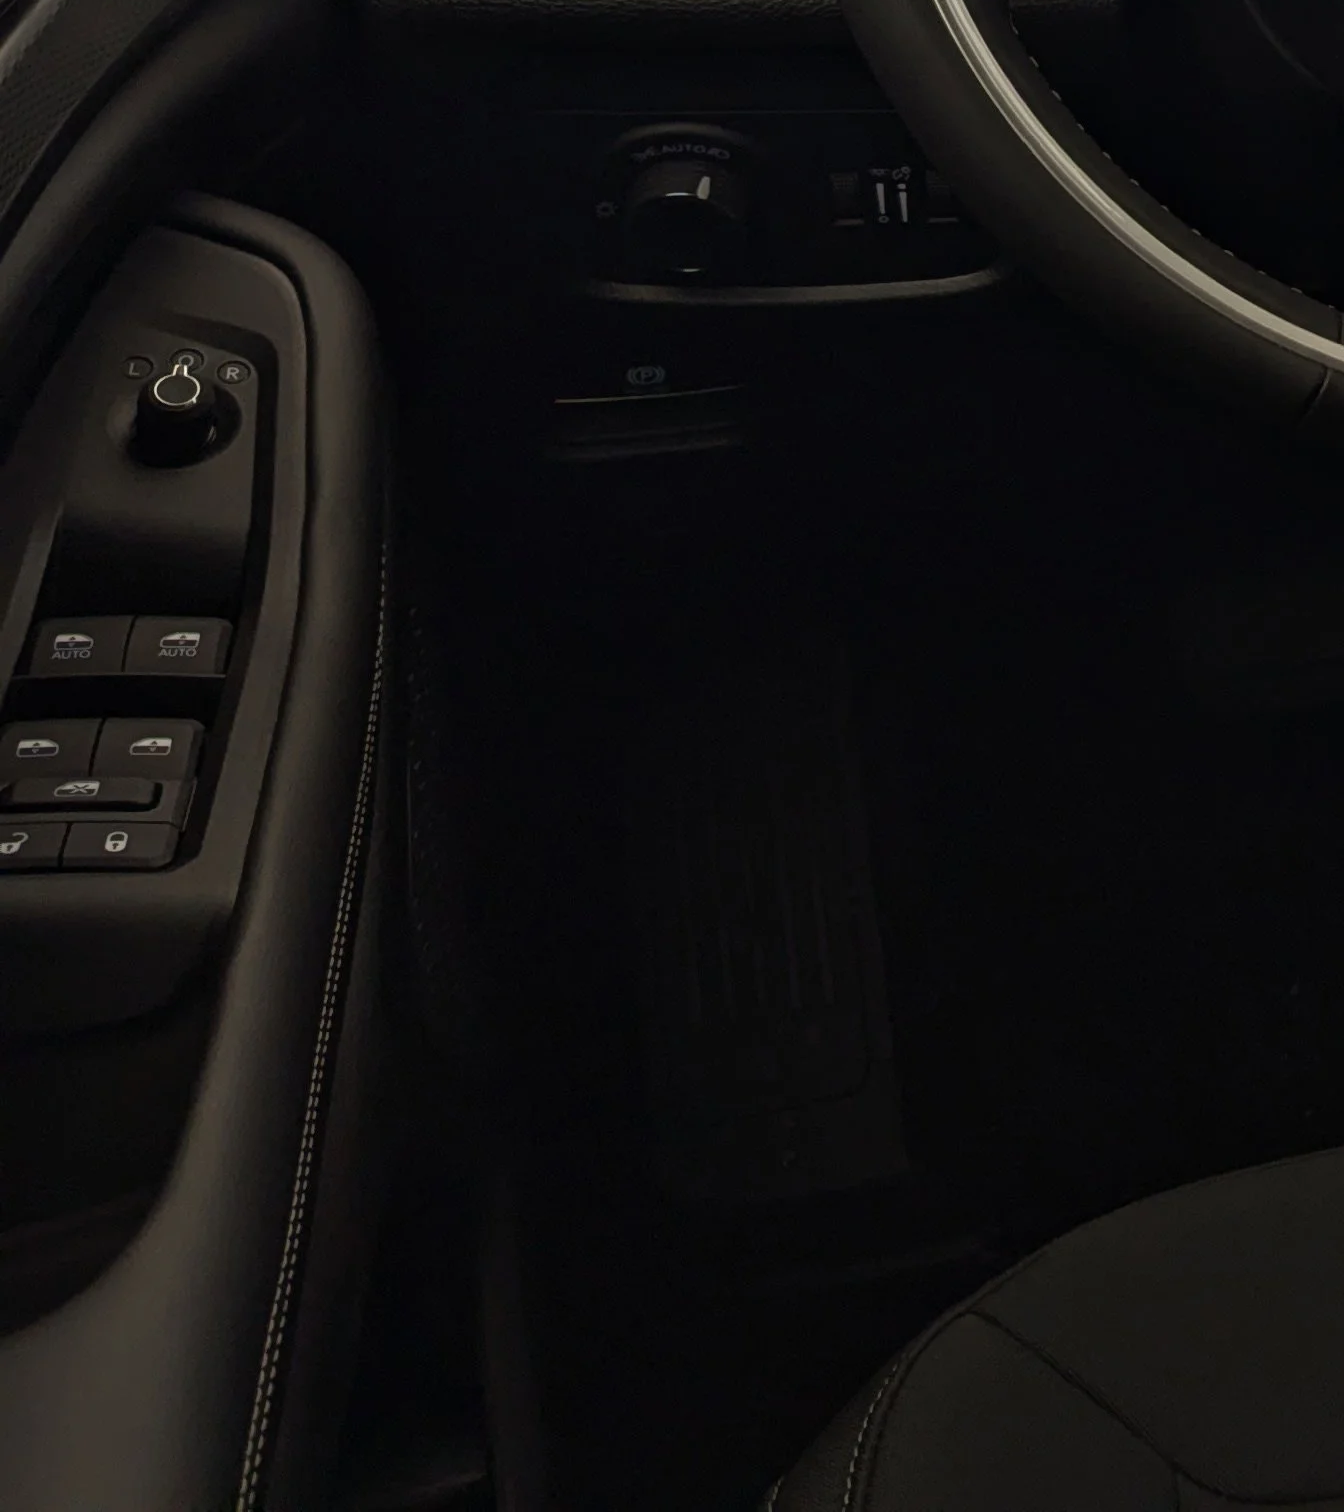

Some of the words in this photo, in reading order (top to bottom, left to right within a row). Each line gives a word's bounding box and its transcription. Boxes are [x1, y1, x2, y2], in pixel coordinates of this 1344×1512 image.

[128, 362, 140, 376] L
[225, 366, 240, 381] R
[50, 650, 91, 660] AUTO
[157, 647, 197, 657] AUTO
